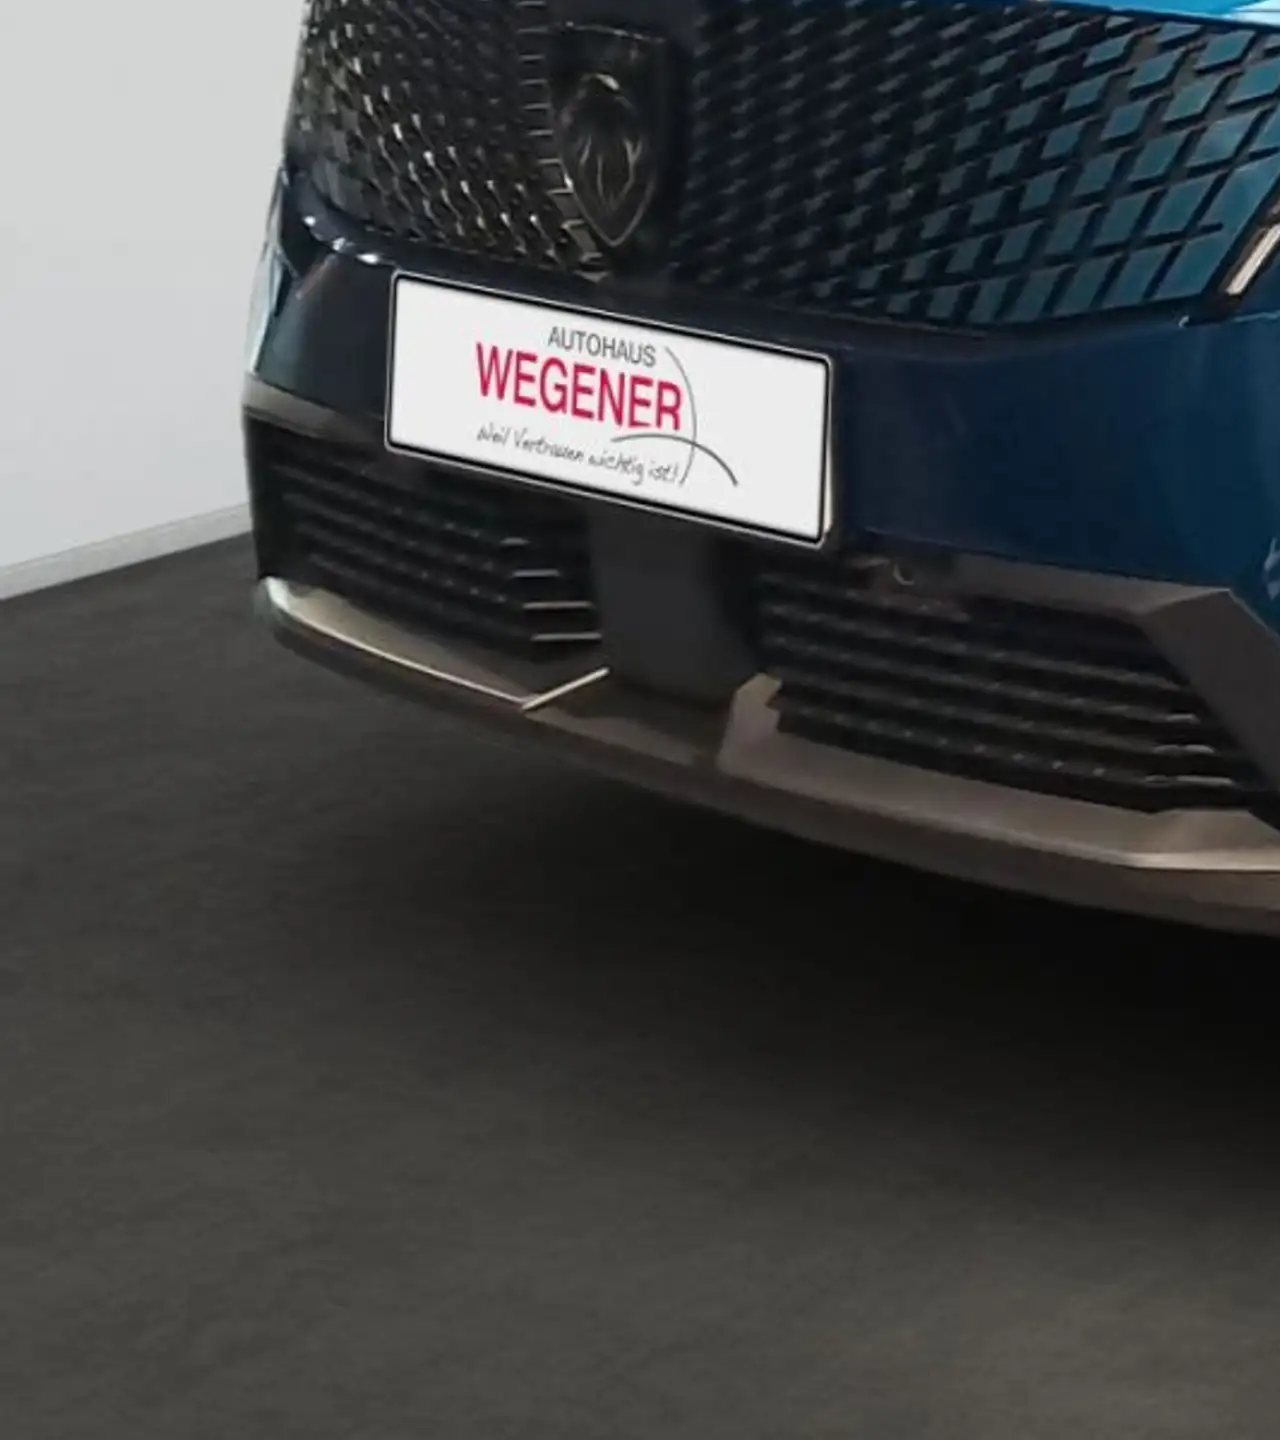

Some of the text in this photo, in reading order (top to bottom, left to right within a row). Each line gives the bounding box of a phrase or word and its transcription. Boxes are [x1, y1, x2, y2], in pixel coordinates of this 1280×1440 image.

[547, 326, 656, 367] AUTOHAUS
[476, 342, 683, 431] WEGENER
[477, 422, 510, 445] Weil
[513, 427, 584, 462] Vertrauen
